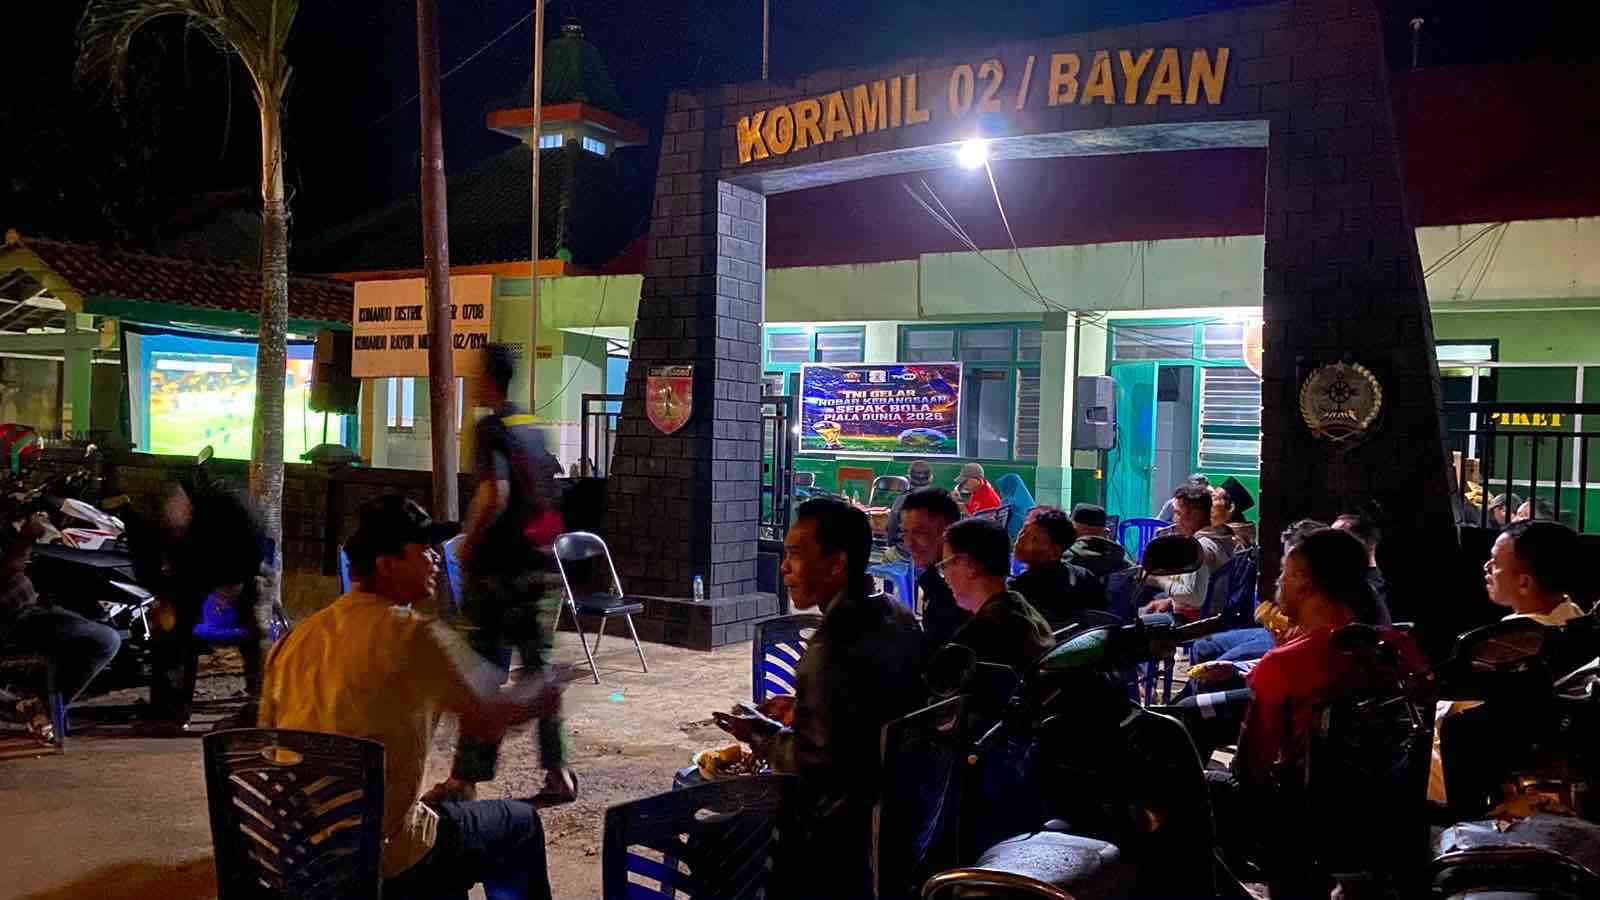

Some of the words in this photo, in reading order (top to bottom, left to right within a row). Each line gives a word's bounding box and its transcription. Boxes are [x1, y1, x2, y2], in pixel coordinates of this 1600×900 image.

[737, 73, 930, 163] KORAMIL
[947, 58, 1004, 117] 02
[1015, 55, 1036, 111] /
[1048, 47, 1230, 107] BAYAN
[844, 390, 867, 399] TNI
[870, 390, 915, 398] GELAR
[818, 398, 860, 407] NOBAR
[863, 396, 946, 405] KEBANGSAAN
[835, 405, 885, 414] SEPAK
[889, 404, 930, 413] BOLA
[823, 413, 860, 422] PIALA
[862, 413, 902, 421] DUNIA
